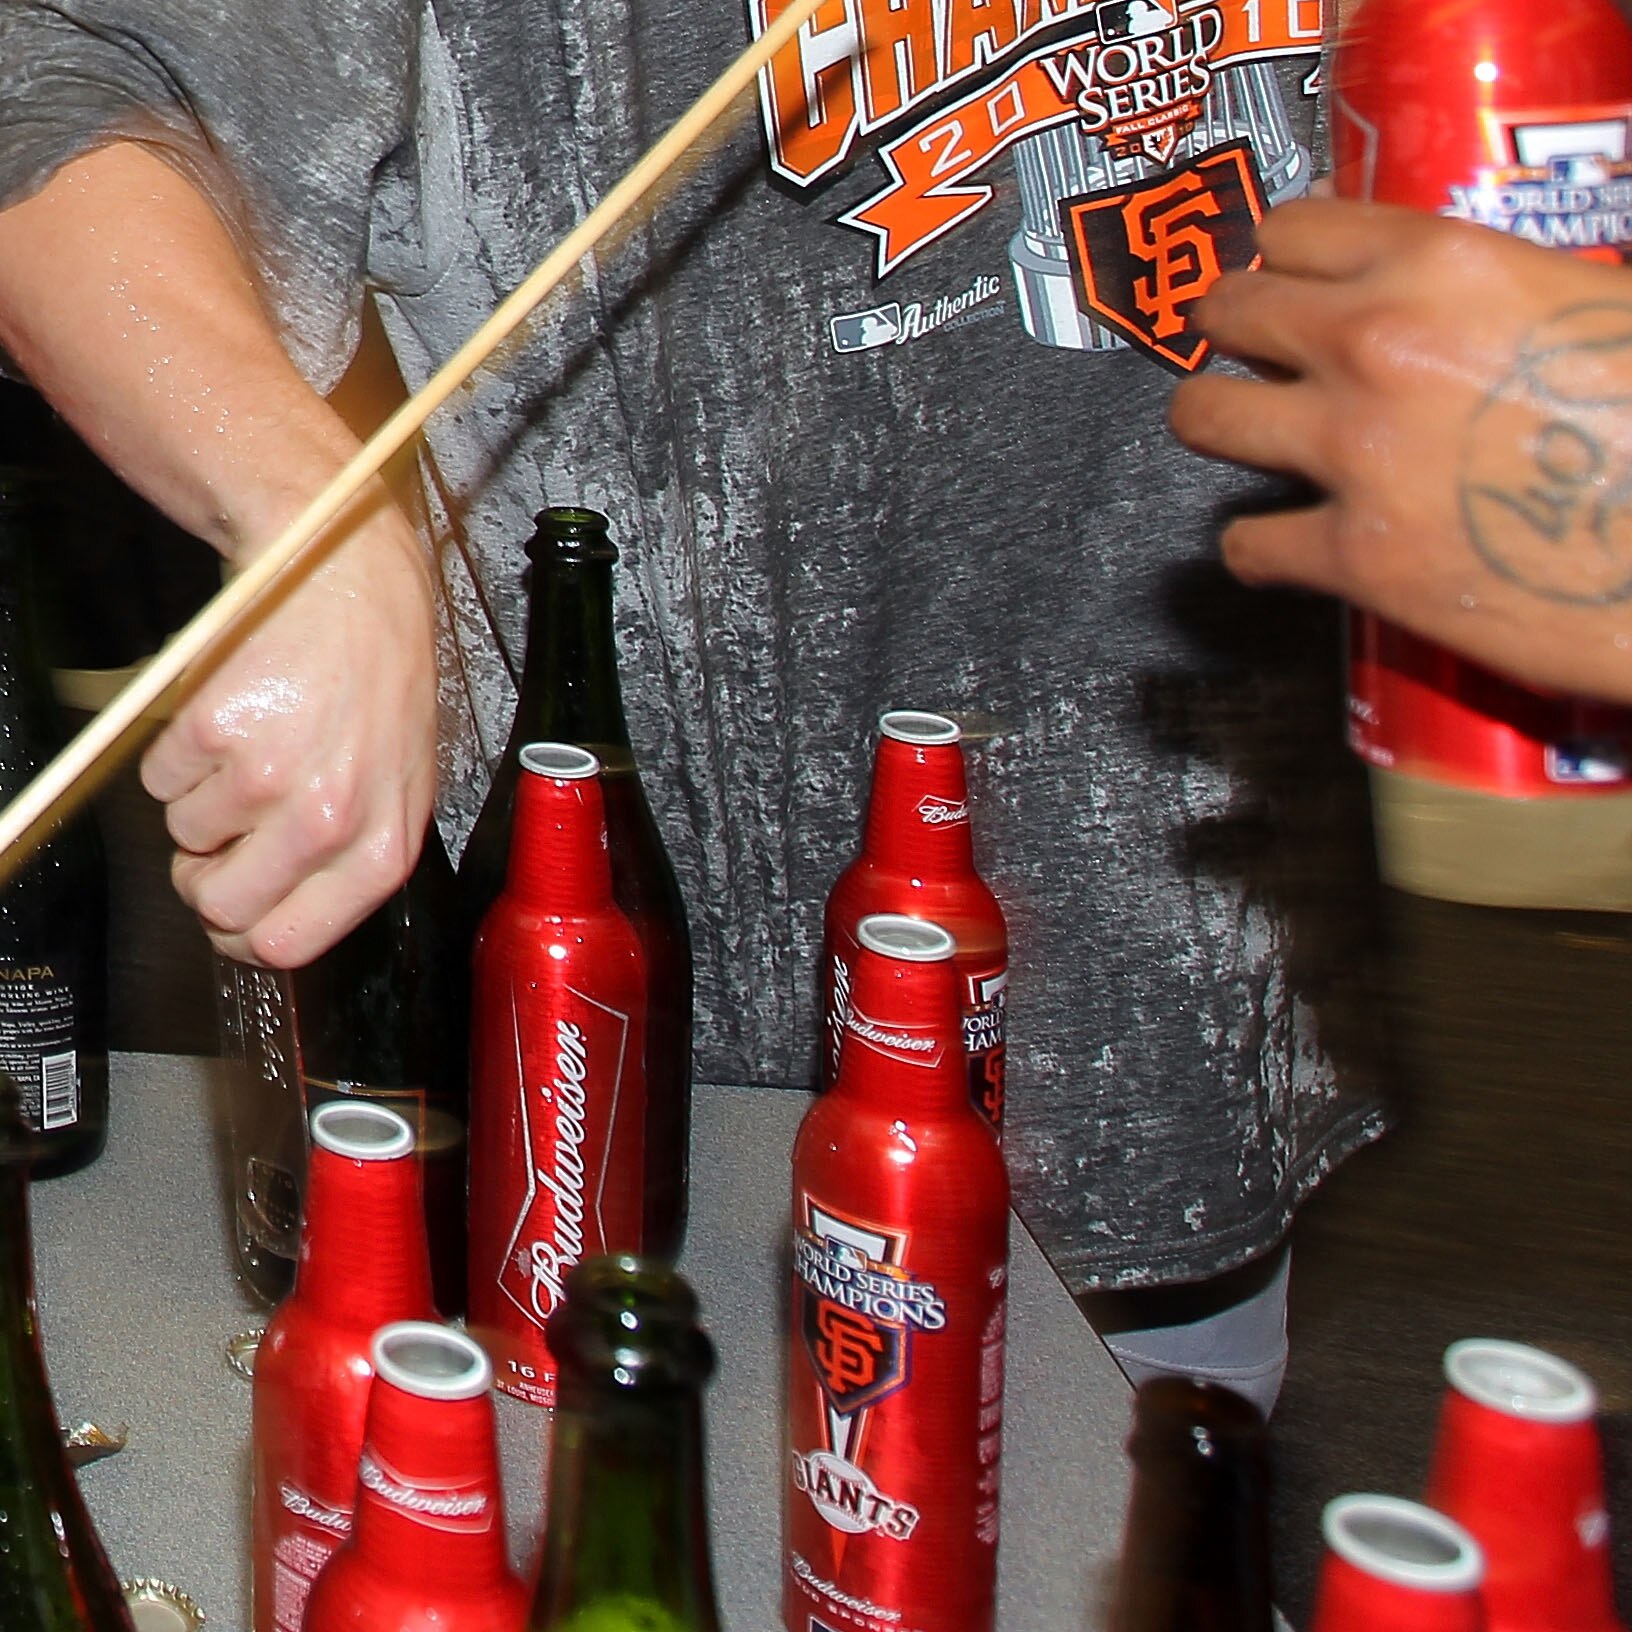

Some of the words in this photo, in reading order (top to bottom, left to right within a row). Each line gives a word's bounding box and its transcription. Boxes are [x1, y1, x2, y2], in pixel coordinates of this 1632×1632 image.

[1040, 5, 1223, 95] WORLD
[918, 80, 1026, 179] 20
[1078, 56, 1211, 131] SERIES
[1115, 119, 1145, 135] FALL
[1147, 105, 1190, 128] CLASSIC
[896, 274, 1002, 346] Authentic
[45, 986, 69, 997] WINE
[532, 1020, 588, 1320] Budweiser
[795, 1252, 946, 1330] HAMPIONS
[796, 1238, 851, 1282] WORLD
[857, 1272, 936, 1304] SERIES
[508, 1360, 535, 1378] 16
[791, 1449, 920, 1540] GIANTS
[792, 1551, 902, 1622] Budweiser
